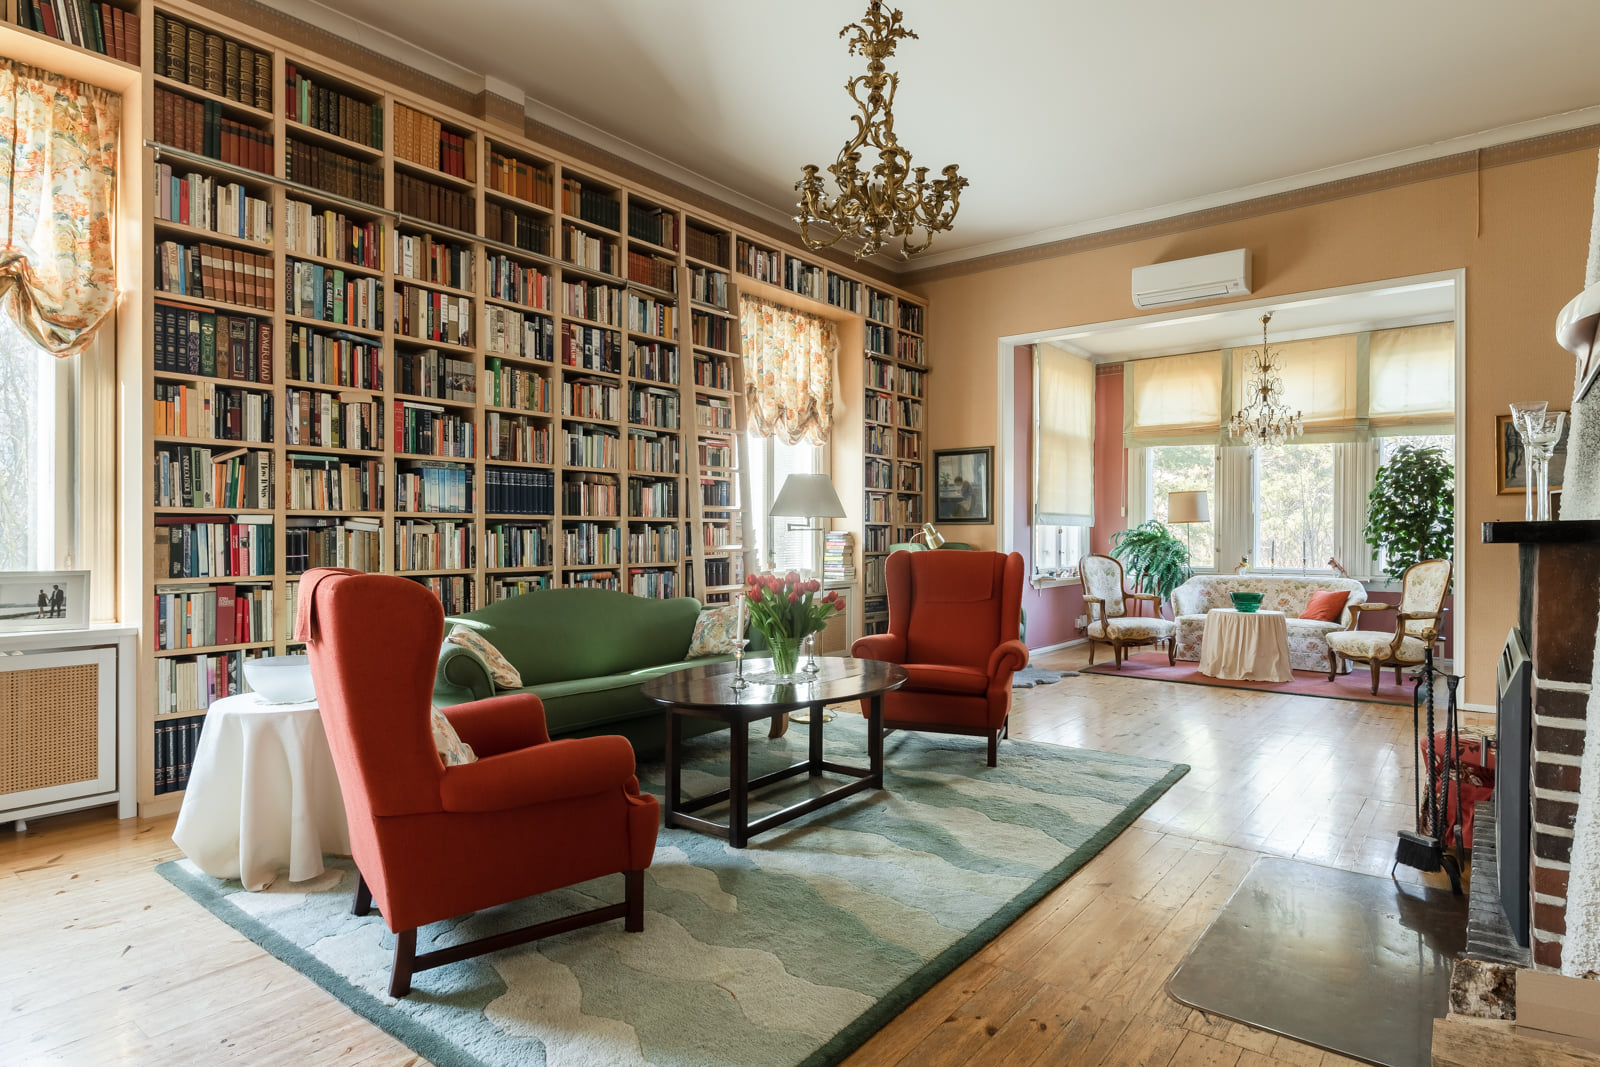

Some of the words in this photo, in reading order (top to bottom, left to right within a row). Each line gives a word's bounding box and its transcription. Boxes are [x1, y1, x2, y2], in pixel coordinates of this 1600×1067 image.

[261, 326, 271, 356] HOMER
[261, 359, 271, 381] ILIAD
[260, 462, 269, 477] How
[260, 485, 269, 498] Was
